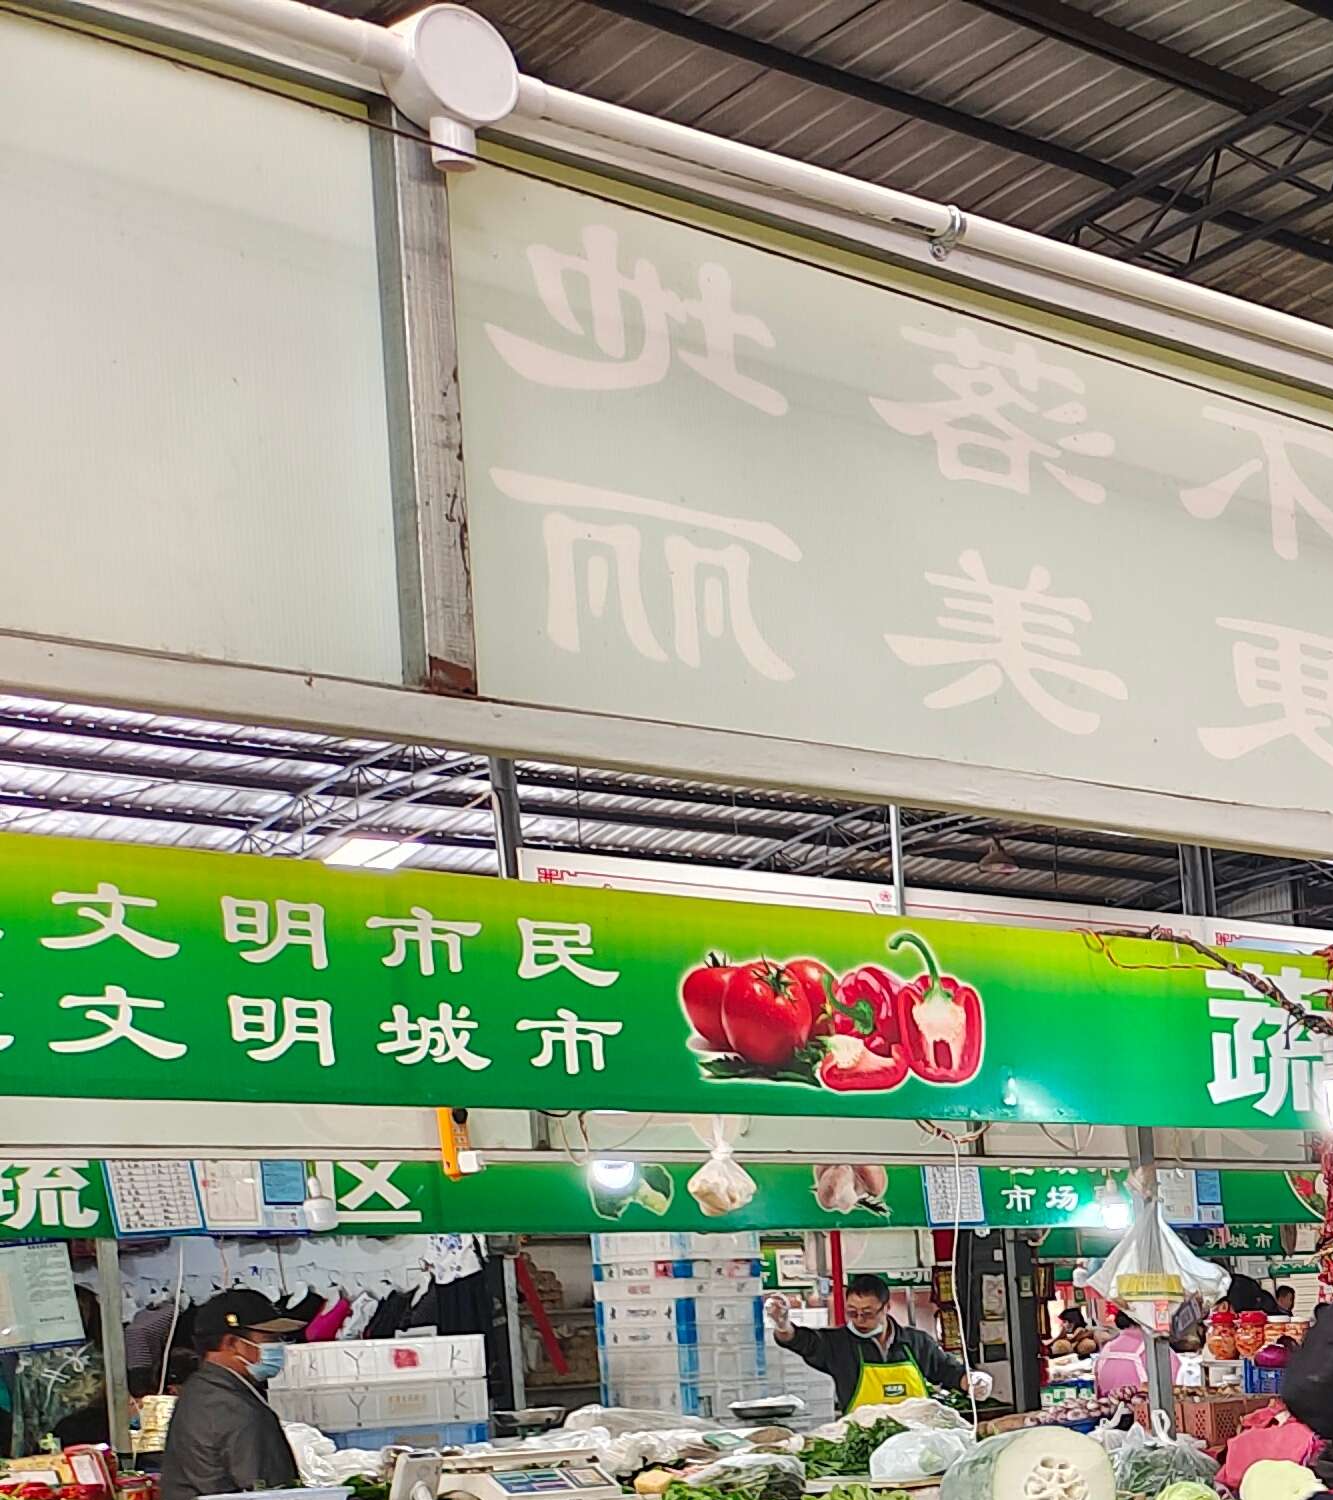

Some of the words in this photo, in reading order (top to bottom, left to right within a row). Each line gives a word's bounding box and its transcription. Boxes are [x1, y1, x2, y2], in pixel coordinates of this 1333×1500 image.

[0, 882, 620, 988] 文明市民
[0, 984, 625, 1076] 文明城市
